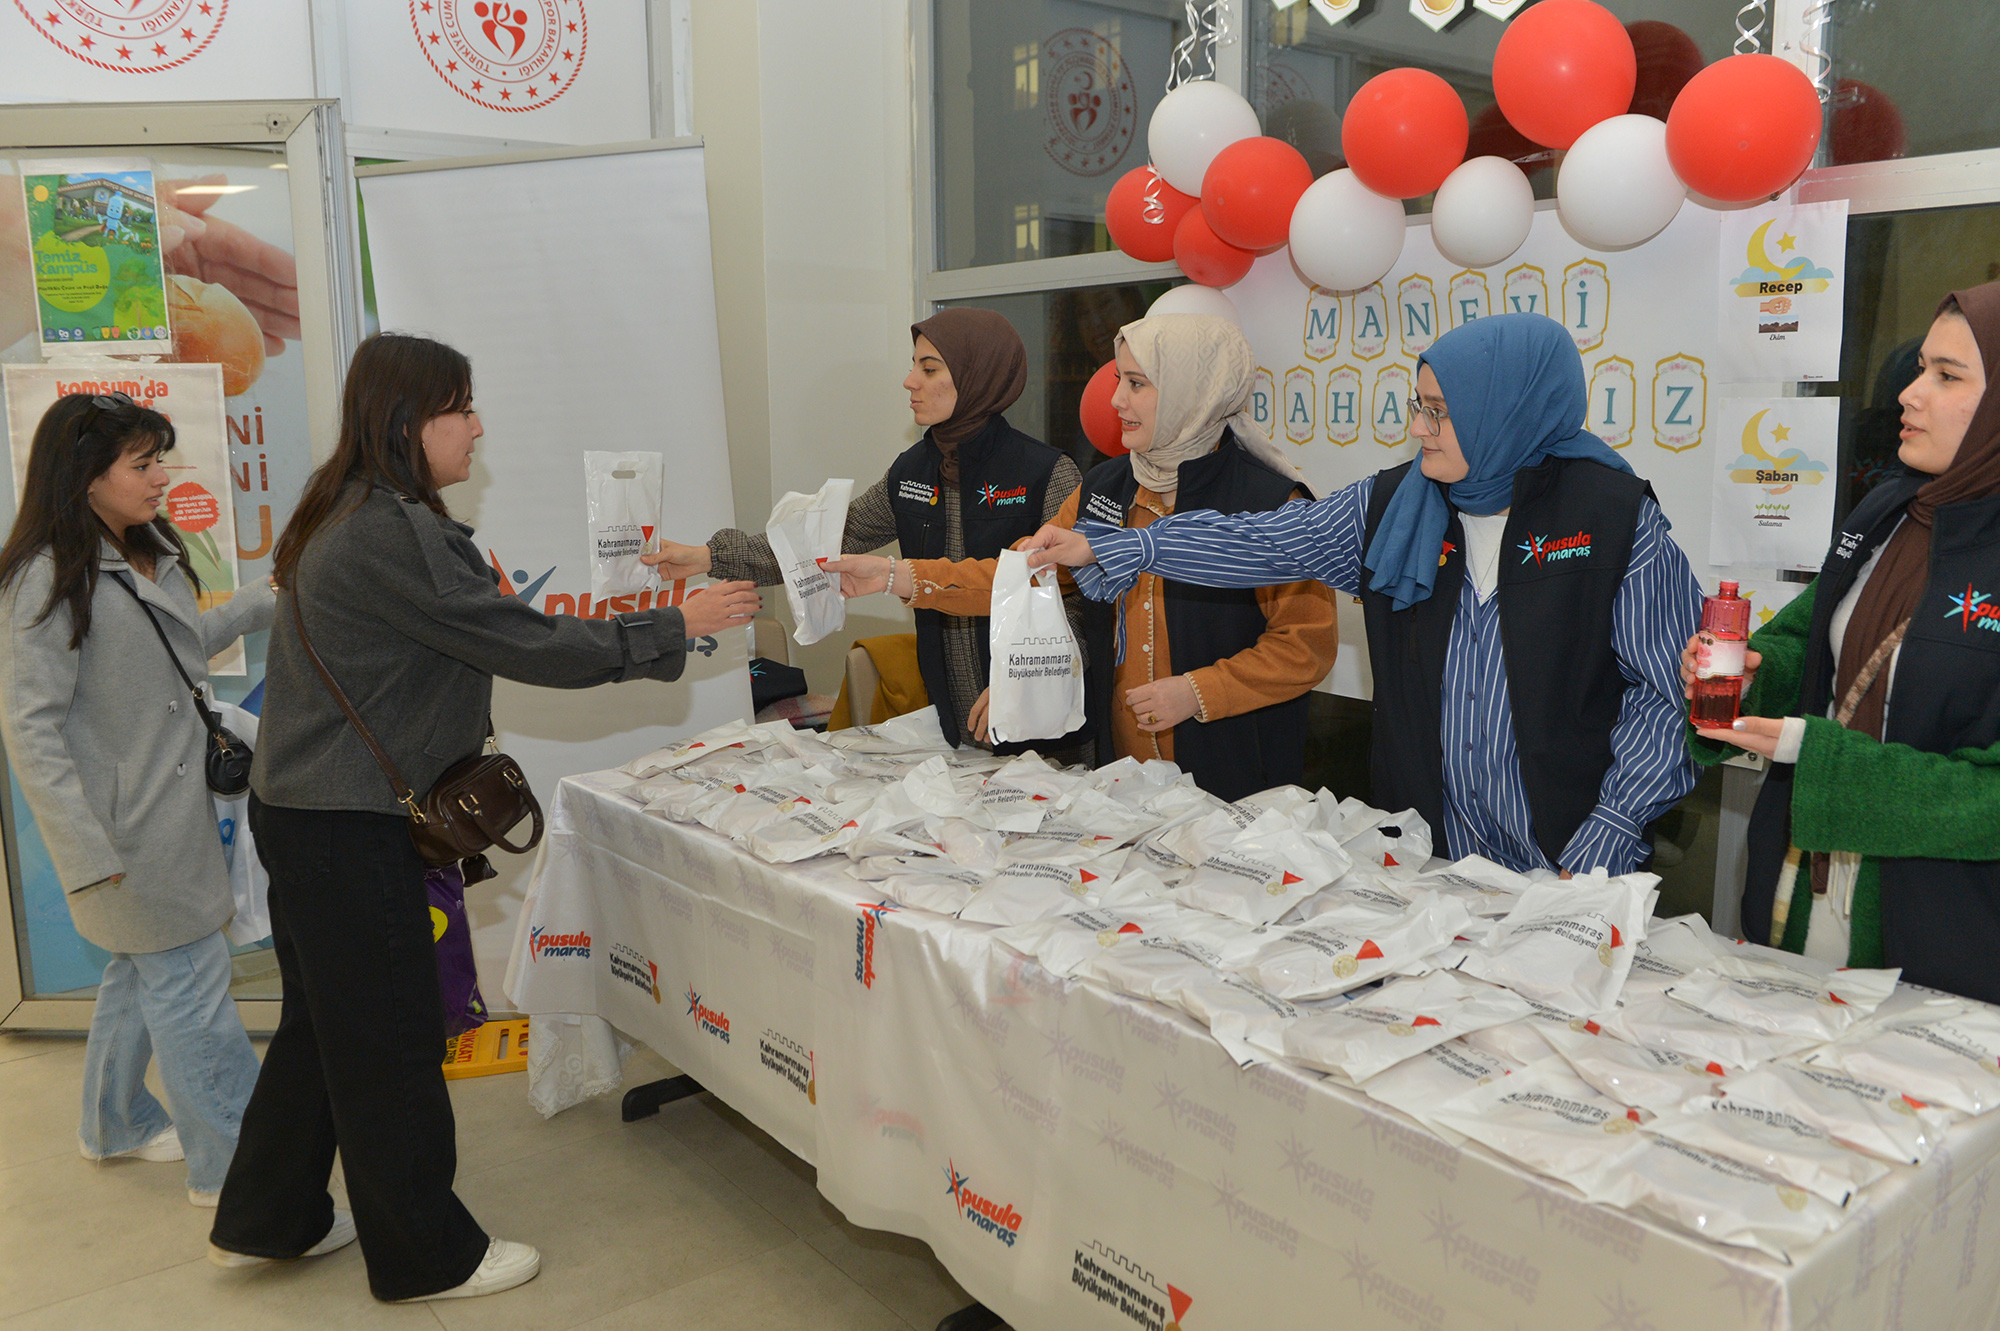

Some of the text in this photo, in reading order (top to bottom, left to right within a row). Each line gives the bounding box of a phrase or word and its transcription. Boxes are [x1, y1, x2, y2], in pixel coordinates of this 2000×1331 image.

[34, 249, 81, 263] Temiz
[36, 260, 98, 277] Kampüs
[1759, 282, 1803, 294] Recep
[1756, 470, 1799, 483] Şaban
[992, 484, 1027, 500] pusula
[996, 495, 1027, 506] maraş
[1541, 530, 1592, 559] pusula
[1547, 545, 1592, 562] maraş
[543, 579, 712, 621] pusul
[1008, 665, 1071, 680] Büyükşehir Belediyesi
[1009, 653, 1072, 667] Kahramanmaraş
[1207, 856, 1273, 880] ahramanmaraş
[536, 930, 592, 952] pusula
[854, 917, 865, 984] maraş
[862, 908, 876, 990] pusula
[1555, 927, 1600, 950] Belediyesi
[543, 946, 591, 960] maraş
[698, 1003, 730, 1032] pusula
[702, 1019, 731, 1045] maraş
[1065, 1044, 1126, 1080] pusula
[1433, 1043, 1491, 1076] manmaraş
[1176, 1098, 1237, 1138] pusula
[1301, 1158, 1376, 1207] pusula
[960, 1186, 1023, 1232] pusula
[966, 1206, 1018, 1249] maraş
[1450, 1232, 1542, 1284] pusula
[1071, 1267, 1119, 1308] Büyükşehir
[1074, 1249, 1166, 1323] Kahramanmaraş
